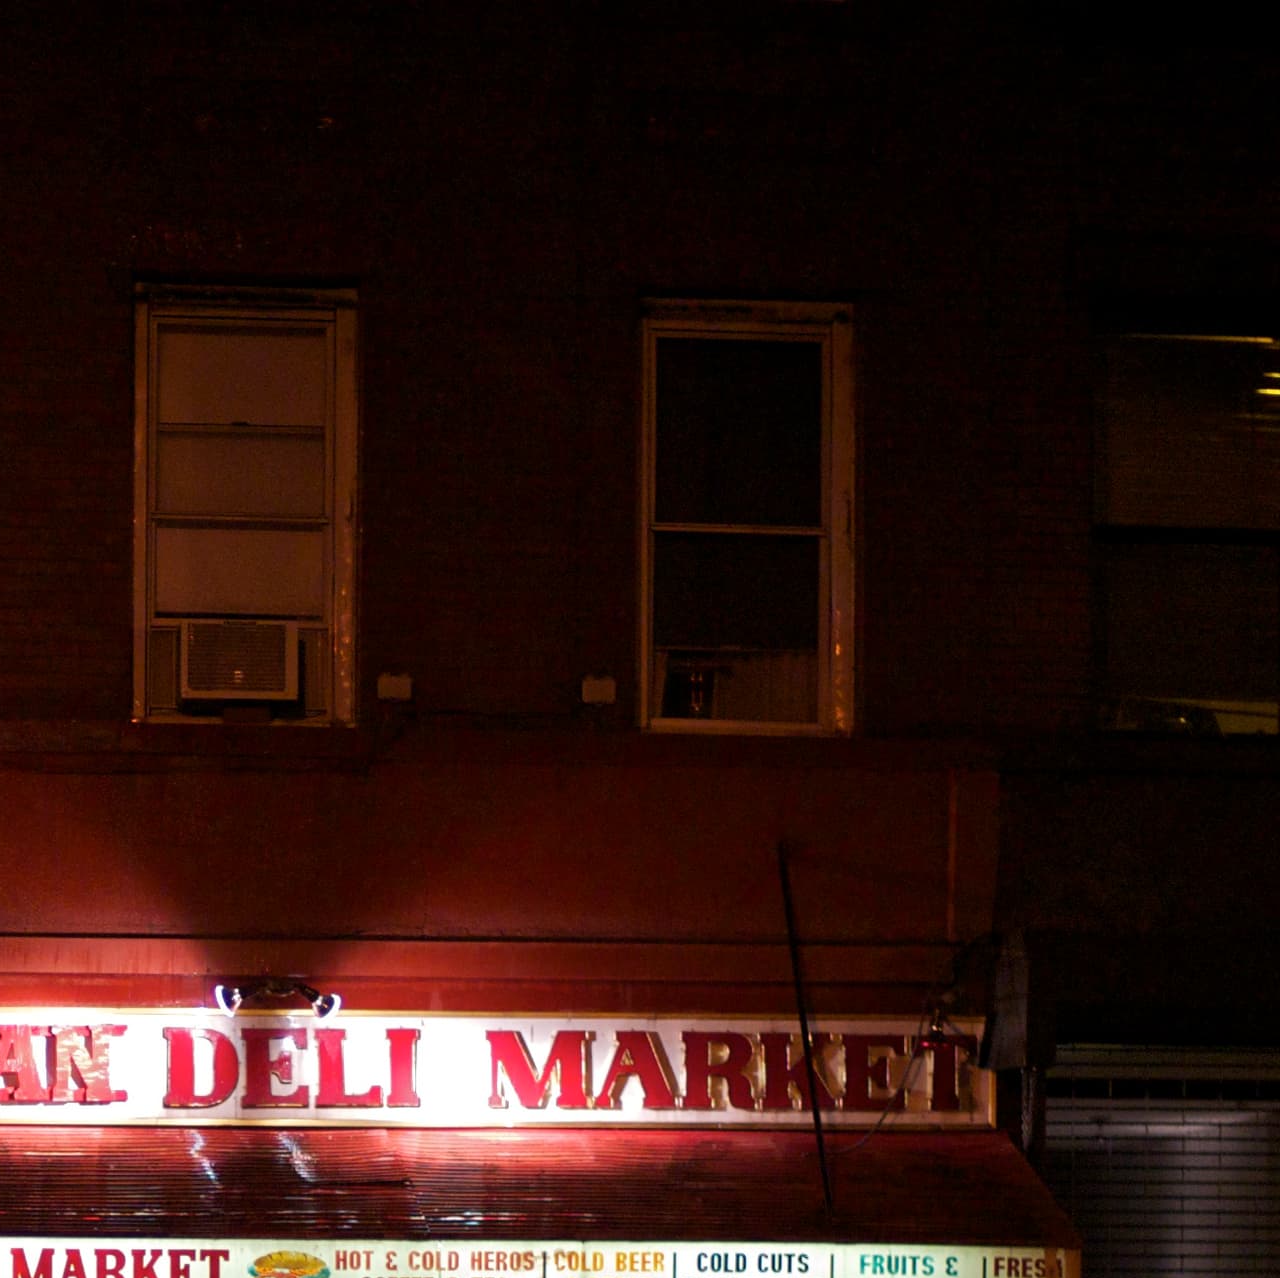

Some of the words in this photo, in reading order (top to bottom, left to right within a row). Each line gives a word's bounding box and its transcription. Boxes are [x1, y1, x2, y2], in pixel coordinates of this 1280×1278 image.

[162, 1026, 422, 1109] DELI
[485, 1029, 978, 1111] MARKET
[335, 1250, 374, 1271] HOT
[385, 1250, 398, 1271] &
[408, 1250, 460, 1272] COLD
[470, 1251, 535, 1272] HEROS
[554, 1251, 604, 1272] COLD
[615, 1252, 665, 1272] BEER
[696, 1252, 747, 1274] COLD
[757, 1253, 810, 1274] CUTS
[859, 1254, 935, 1277] FRUITS
[945, 1256, 959, 1277] &
